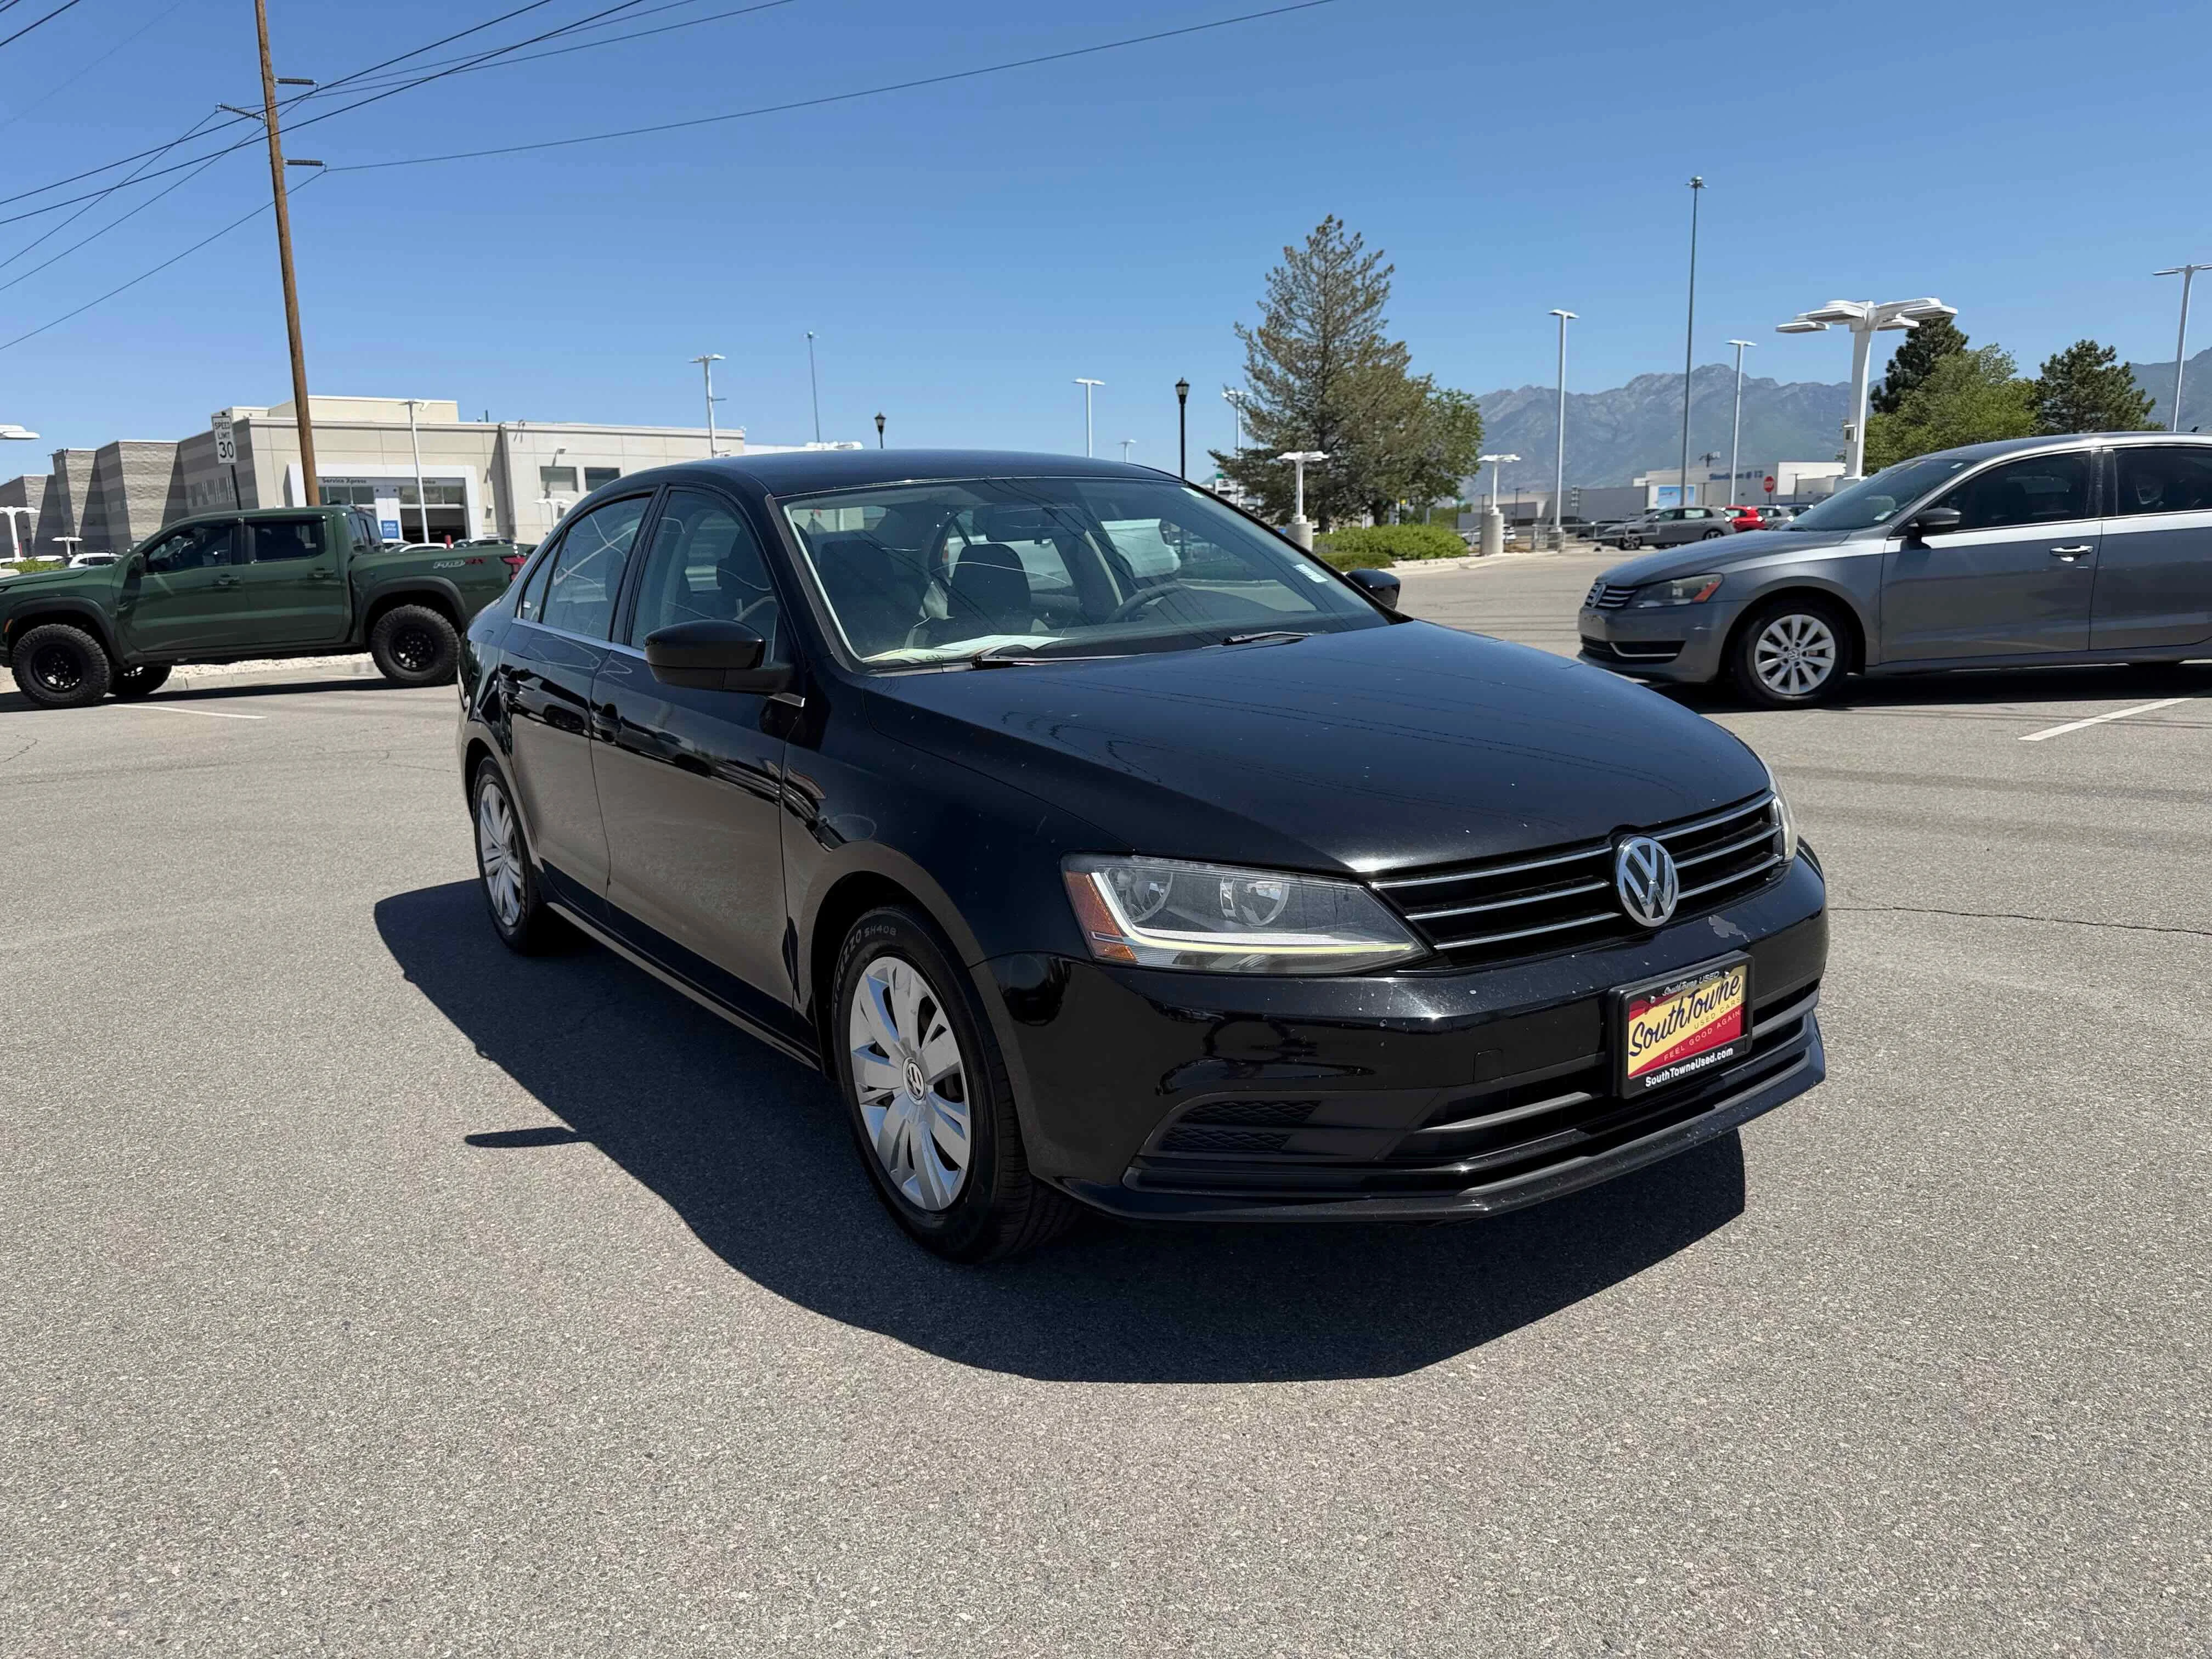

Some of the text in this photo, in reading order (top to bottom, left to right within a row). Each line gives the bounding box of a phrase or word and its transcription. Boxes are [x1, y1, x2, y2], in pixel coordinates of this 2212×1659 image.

[215, 421, 230, 430] SPEED
[217, 431, 230, 439] LIMIT
[219, 441, 234, 458] 30
[1699, 970, 1720, 984] USED
[1629, 975, 1741, 1057] SouthTowne
[1694, 996, 1741, 1029] USED CARS
[1663, 1009, 1741, 1062] FEEL GOOD AGAIN
[1645, 1047, 1734, 1087] SouthTowneUsed.com
